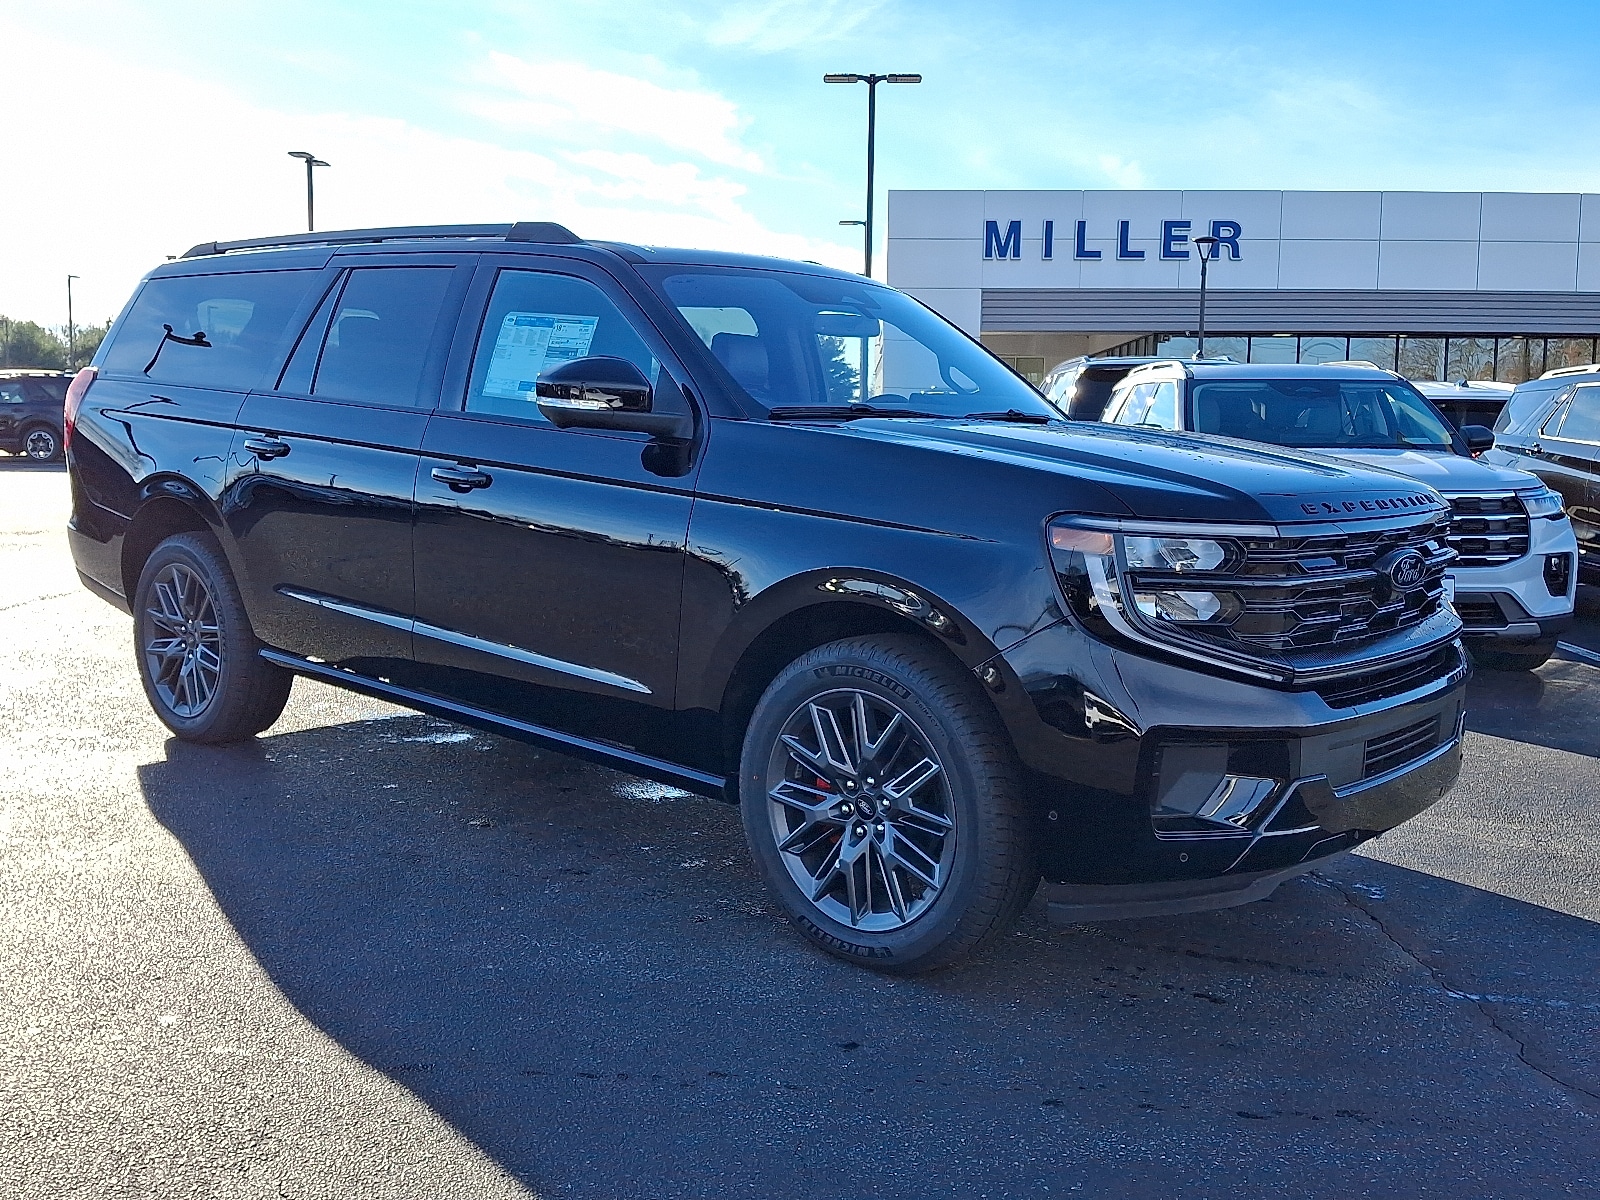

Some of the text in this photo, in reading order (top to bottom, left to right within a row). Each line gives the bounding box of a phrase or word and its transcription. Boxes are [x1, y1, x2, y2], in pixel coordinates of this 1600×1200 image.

[983, 219, 1243, 260] MILLER
[1300, 494, 1435, 515] EXPEDITION
[1398, 557, 1420, 582] Ford
[835, 665, 908, 697] MICHELIN
